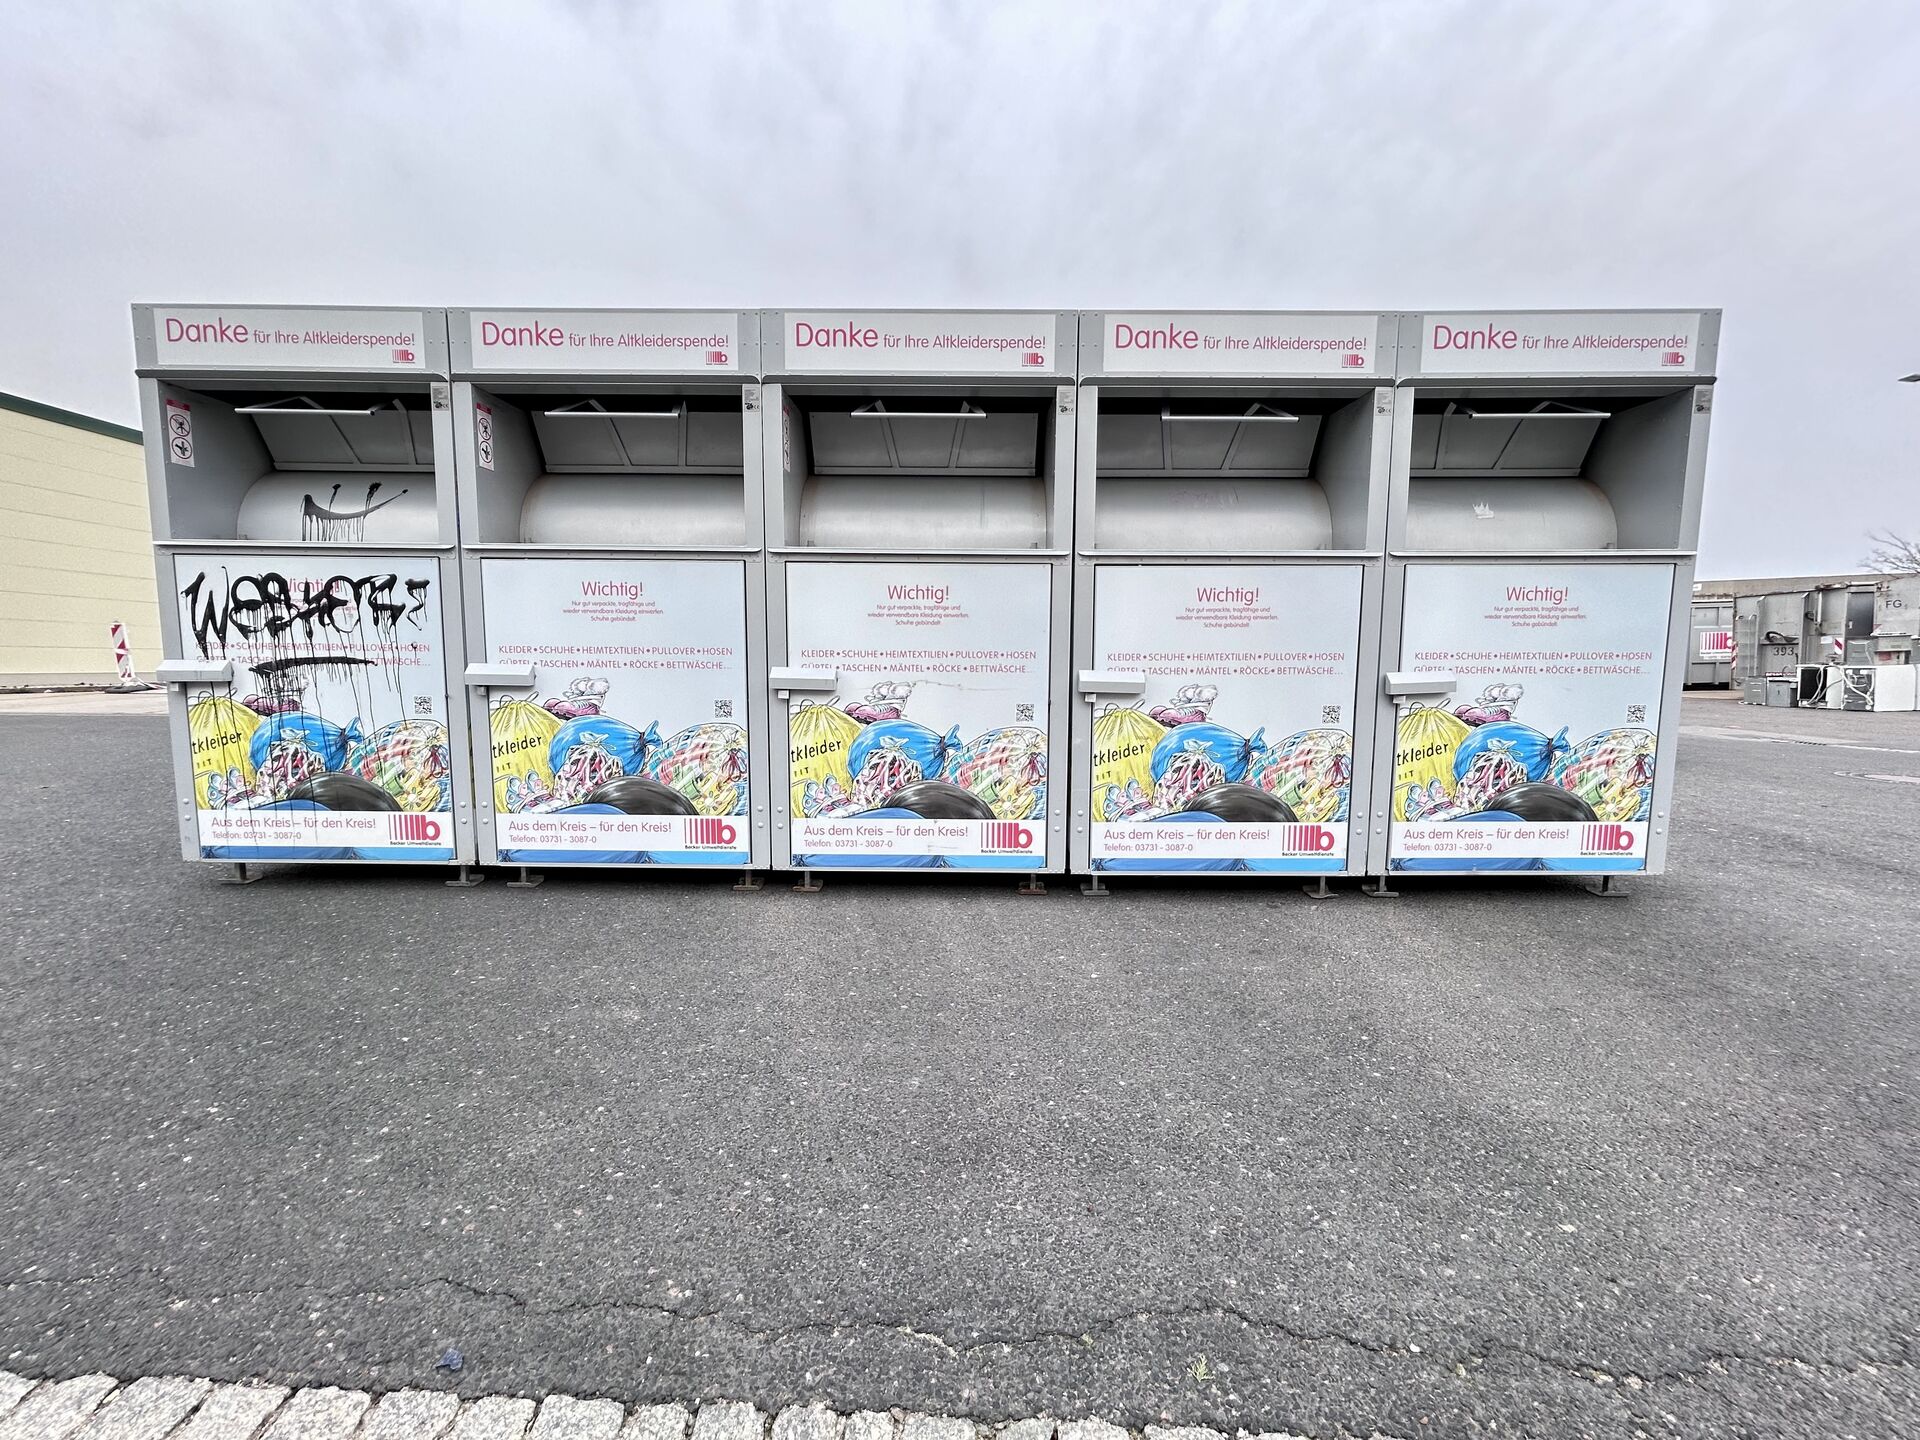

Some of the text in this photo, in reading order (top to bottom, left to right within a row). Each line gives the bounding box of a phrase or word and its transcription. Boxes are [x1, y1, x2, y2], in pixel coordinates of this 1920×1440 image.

[166, 317, 415, 347] Danke für Ihre Altkleiderspende!
[482, 321, 729, 350] Danke für Ihre Altkleiderspende!
[796, 321, 1046, 352] Danke für Ihre Altkleiderspende!
[1115, 323, 1367, 352] Danke für Ihre Altkleiderspende!
[1433, 323, 1688, 351] Danke für Ihre Altkleiderspende!
[582, 581, 643, 599] Wichtig!
[888, 585, 949, 603] Wichtig!
[1197, 587, 1259, 605] Wichtig!
[1507, 587, 1568, 605] Wichtig!
[1886, 600, 1902, 608] FG
[539, 646, 575, 654] SCHUHE
[582, 646, 644, 654] HEIMTEXTILIEN
[652, 647, 695, 655] PULLOVER
[703, 647, 732, 655] HOSEN
[842, 650, 878, 658] SCHUHE
[886, 650, 948, 658] HEIMTEXTILIEN
[956, 651, 998, 659] PULLOVER
[1007, 651, 1036, 659] HOSEN
[1415, 652, 1448, 660] KLEIDER
[1456, 652, 1492, 660] SCHUHE
[1499, 652, 1562, 660] HEIMTEXTILIEN
[1570, 652, 1613, 660] PULLOVER
[1773, 647, 1794, 656] 393
[1107, 653, 1344, 661] KLEIDER SCHUHE HEIMTEXTILIEN PULLOVER HOSEN
[540, 660, 578, 668] TASCHEN
[587, 659, 621, 668] MÄNTEL
[630, 659, 658, 668] RÖCKE
[842, 664, 881, 672] TASCHEN
[890, 663, 924, 672] MÄNTEL
[933, 663, 961, 673] RÖCKE
[1148, 667, 1187, 675] TASCHEN
[1196, 666, 1230, 675] MÄNTEL
[1240, 666, 1270, 675] RÖCKE
[1455, 666, 1494, 674] TASCHEN
[1503, 665, 1537, 674] MÄNTEL
[1546, 665, 1575, 674] RÖCKE
[192, 732, 242, 755] tkleider
[493, 735, 542, 758] tkleider
[791, 739, 842, 762] tkleider
[1094, 742, 1145, 766] tkleider
[1397, 742, 1448, 766] tkleider
[212, 818, 375, 828] Aus dem Kreis für den Kreis!
[509, 821, 671, 833] Aus dem Kreis für den Kreis!
[804, 826, 968, 837] Aus dem Kreis für den Kreis!
[1104, 829, 1269, 840] Aus dem Kreis für den Kreis!
[1404, 828, 1568, 839] Aus dem Kreis für den Kreis!
[836, 840, 857, 848] 03731
[866, 840, 892, 848] 3087-0
